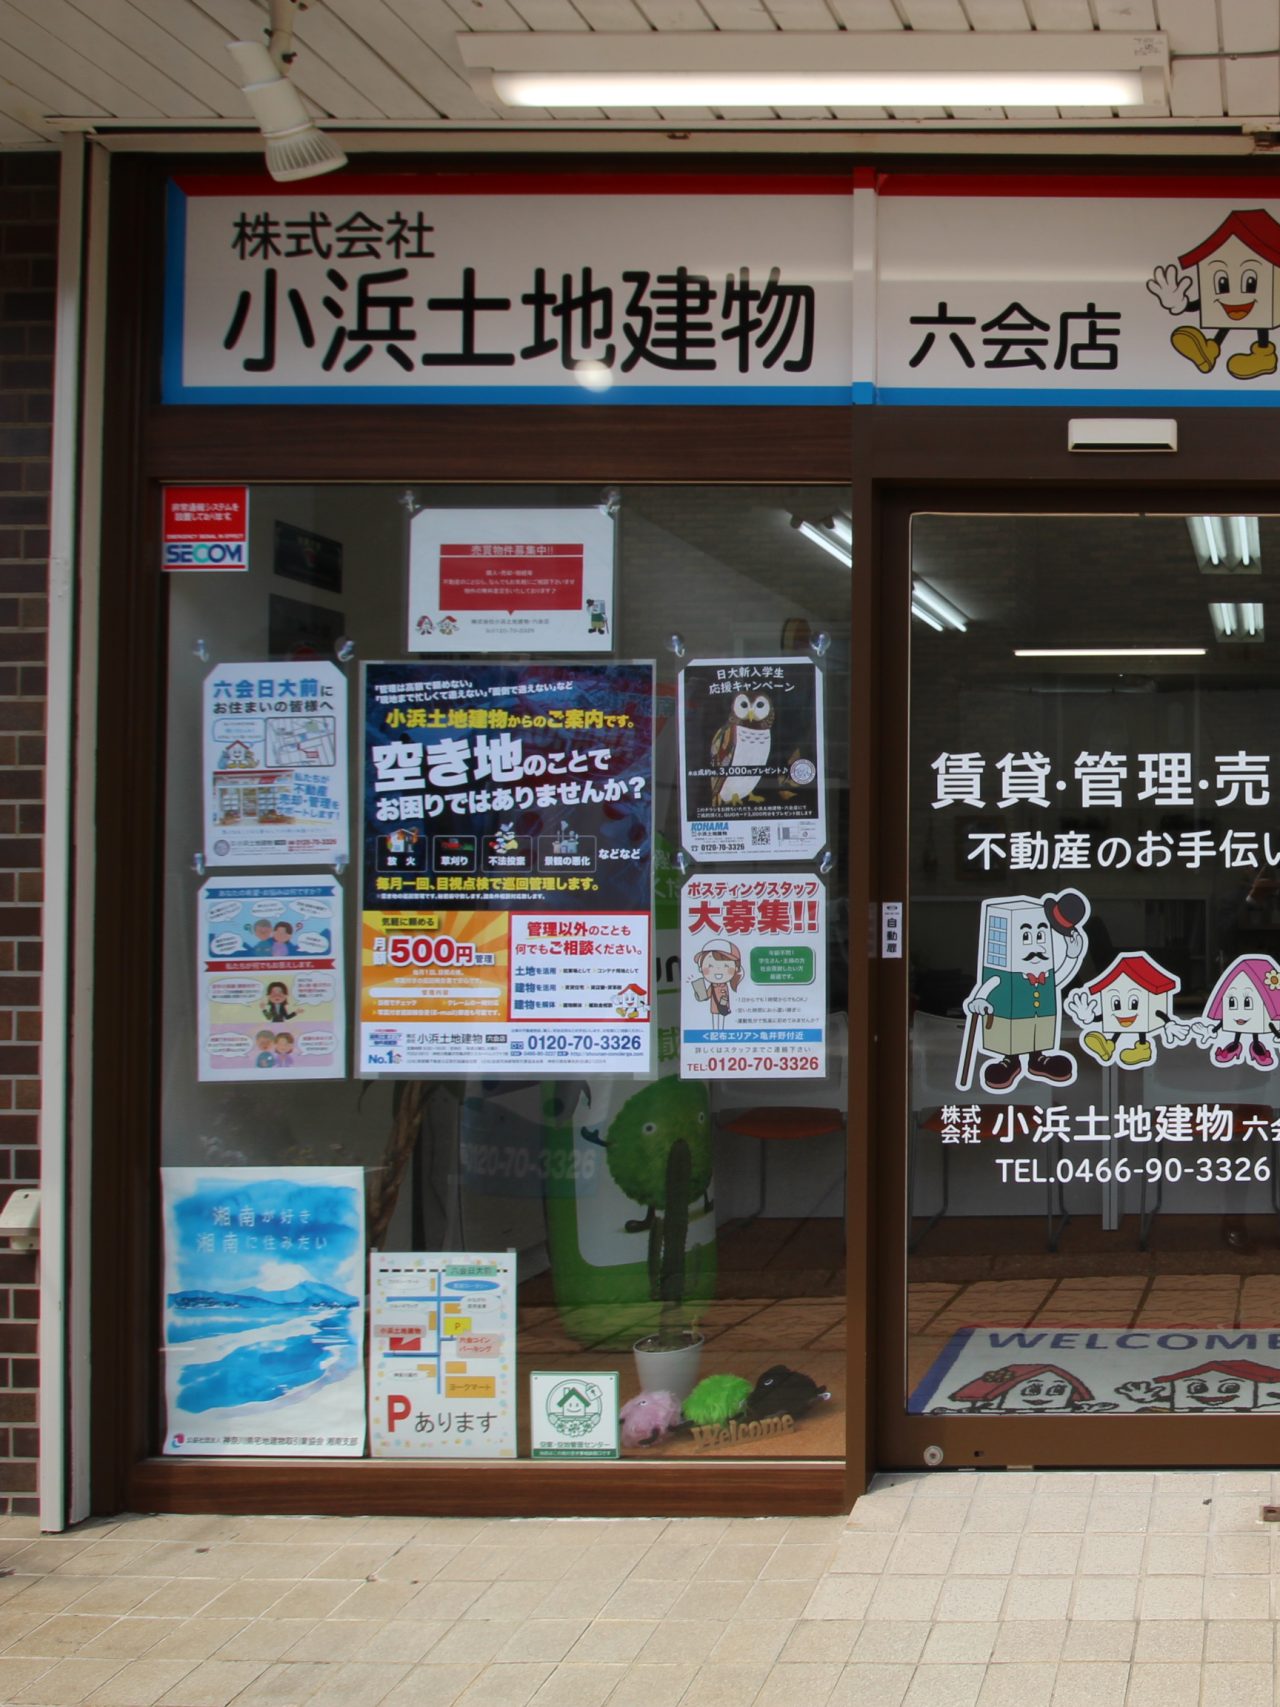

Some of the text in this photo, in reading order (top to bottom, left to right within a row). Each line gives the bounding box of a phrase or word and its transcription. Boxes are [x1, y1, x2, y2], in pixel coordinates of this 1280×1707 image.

[231, 211, 435, 260] 株式会社
[223, 265, 815, 374] 小浜土地建物
[909, 302, 1122, 371] 六会店
[167, 544, 241, 563] SECOM
[717, 667, 785, 681] 日大新入学生
[214, 679, 333, 698] 六会日大前に
[709, 681, 795, 695] 応援キャンペーン
[214, 701, 334, 714] お住まいの皆様へ
[386, 708, 635, 729] 小浜土地建物からのご案内です。
[372, 733, 611, 792] 空き地のことで
[376, 777, 646, 821] お困りではありませんか?
[691, 822, 729, 831] KOHAMA
[599, 848, 640, 860] などなど
[688, 882, 818, 897] ポスティングスタッフ
[688, 900, 819, 934] 大募集!!
[527, 921, 631, 937] 管理以外のことも
[516, 940, 642, 956] 何でもご相談ください。
[417, 1033, 483, 1044] 小浜土地建物
[528, 1035, 641, 1050] 0120-70-3326
[687, 1056, 819, 1072] TEL:0120-70-3326
[940, 1105, 981, 1124] 株式
[992, 1104, 1233, 1143] 小浜土地建物
[940, 1125, 981, 1144] 会社
[995, 1156, 1271, 1183] TEL.0466-90-3326
[212, 1206, 312, 1227] 湘南が好き
[197, 1232, 327, 1253] 湘南に住みたい
[387, 1395, 497, 1433] P あります
[691, 1413, 796, 1447] Welcome
